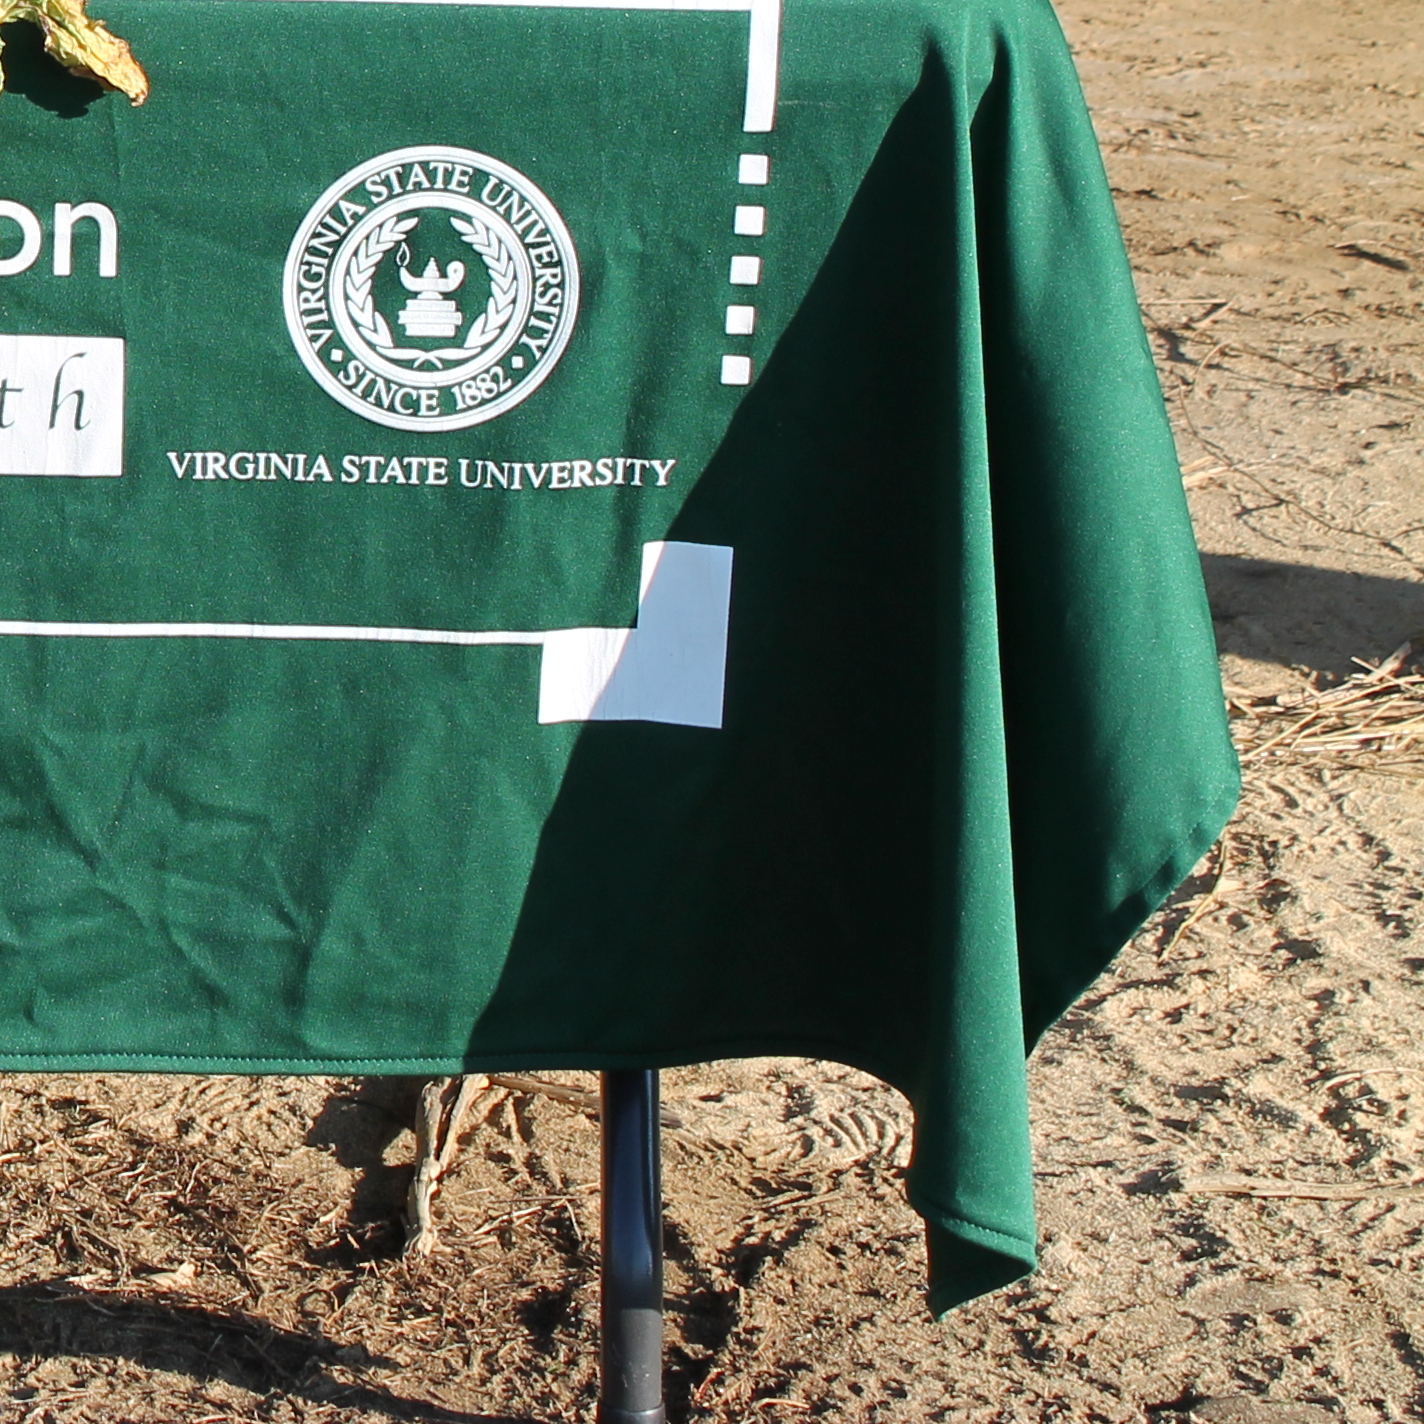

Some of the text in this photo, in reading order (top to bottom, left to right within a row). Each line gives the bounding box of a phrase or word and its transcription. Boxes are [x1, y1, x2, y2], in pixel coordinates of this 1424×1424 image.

[299, 162, 563, 360] VIRGINIA STATE UNIVERSITY
[339, 359, 512, 417] SINCE 1882
[166, 451, 678, 491] VIRGINIA STATE UNIVERSITY
